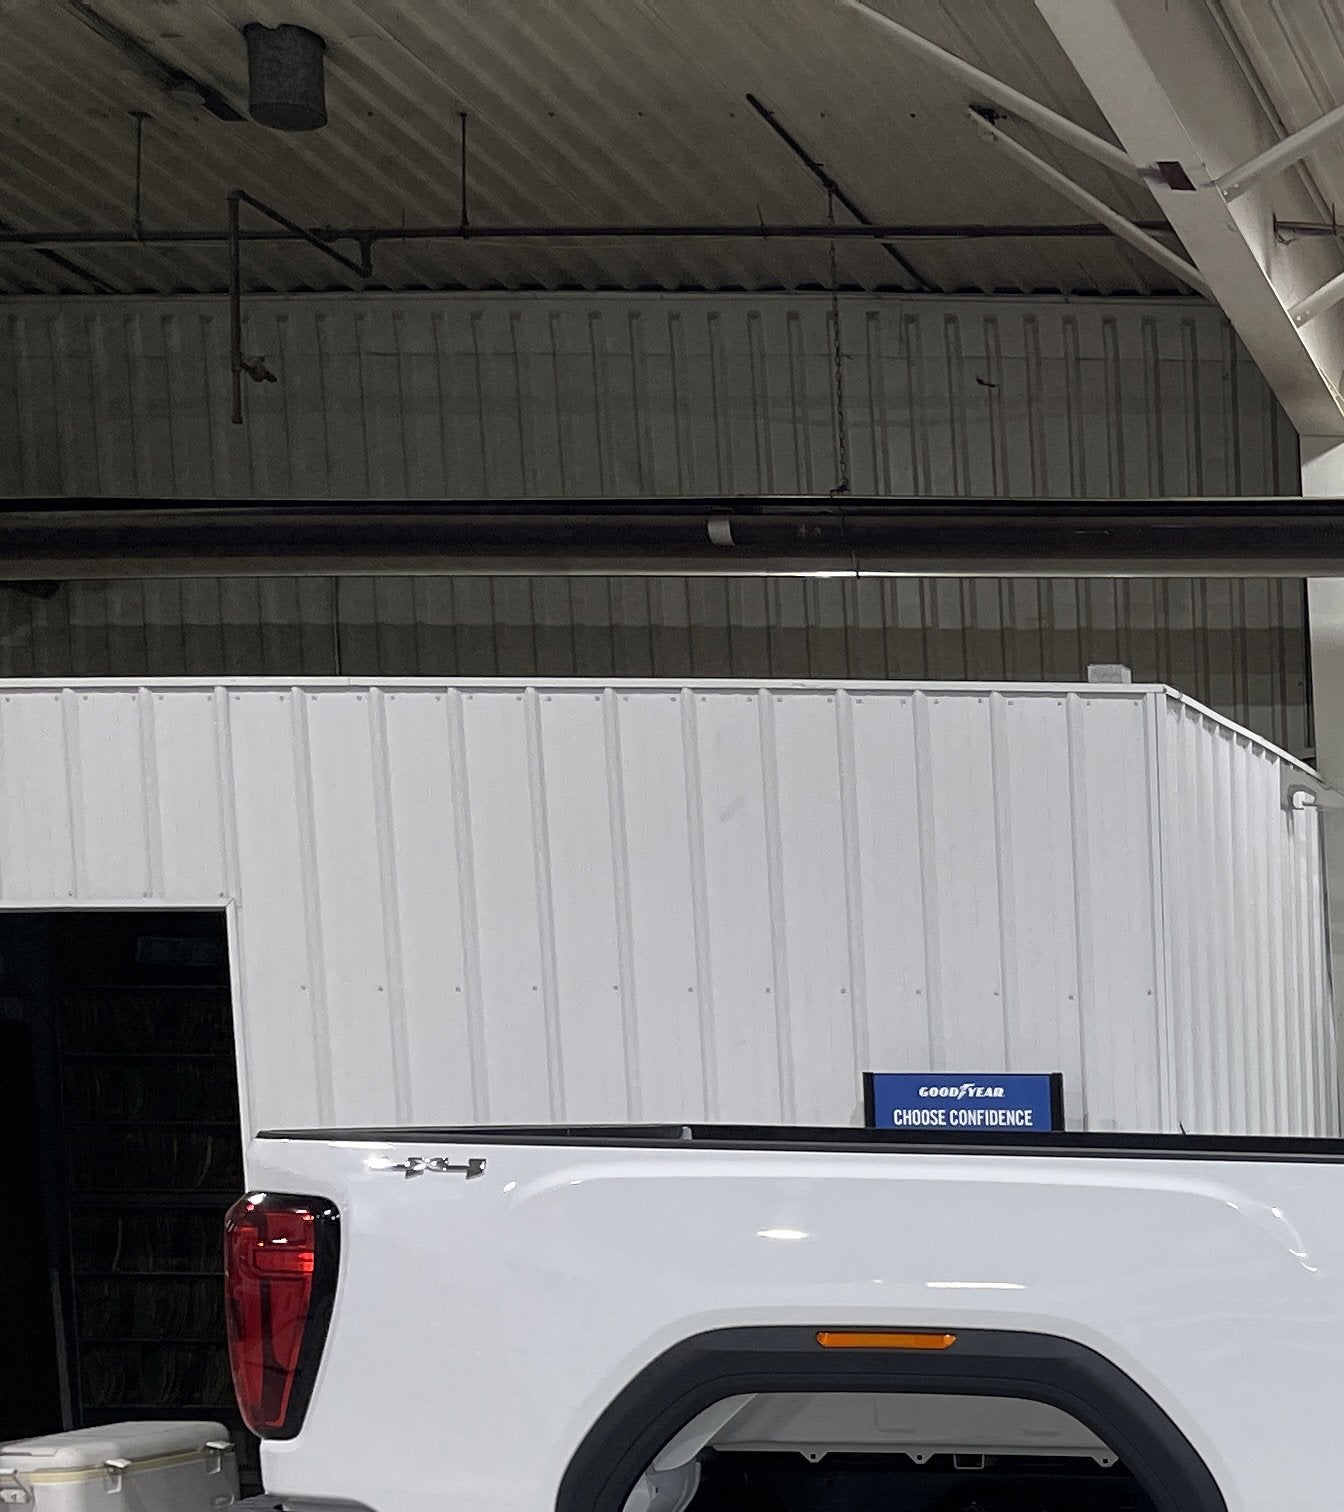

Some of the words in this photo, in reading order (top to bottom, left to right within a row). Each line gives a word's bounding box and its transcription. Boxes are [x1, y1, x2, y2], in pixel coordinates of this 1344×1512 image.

[918, 1084, 1005, 1098] GOODYEAR
[893, 1108, 947, 1126] CHOOSE
[949, 1109, 1034, 1127] CONFIDENCE
